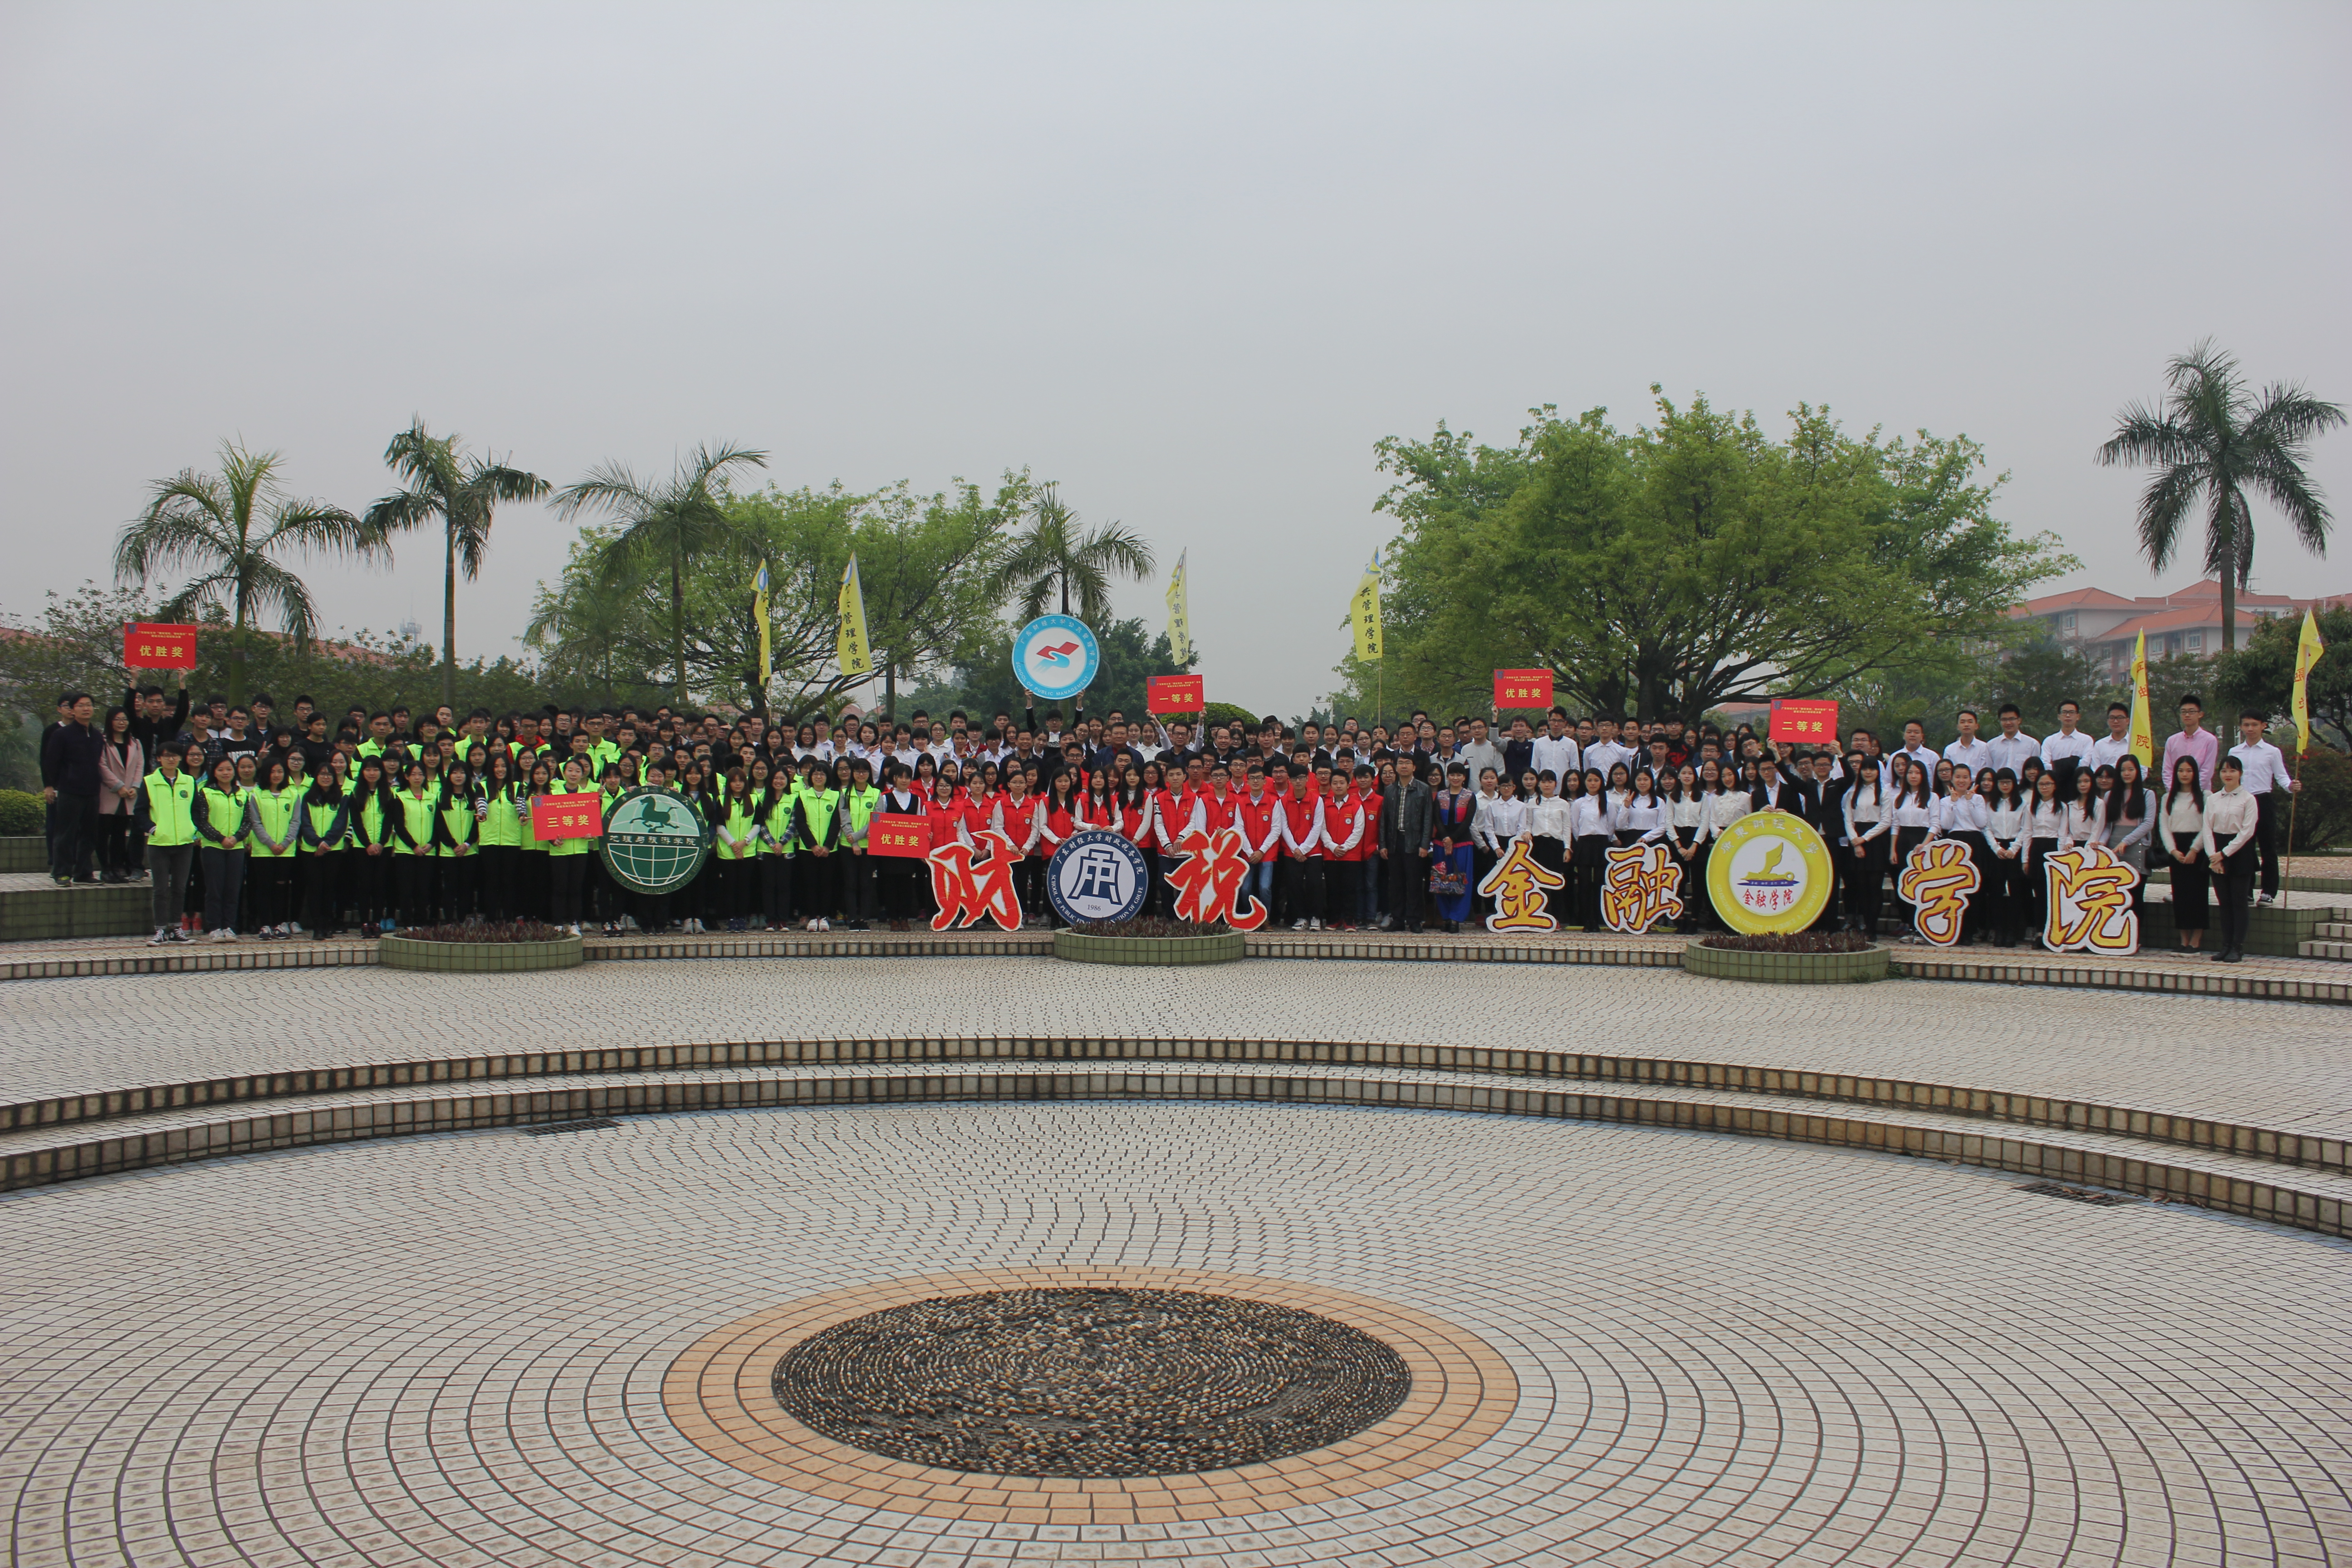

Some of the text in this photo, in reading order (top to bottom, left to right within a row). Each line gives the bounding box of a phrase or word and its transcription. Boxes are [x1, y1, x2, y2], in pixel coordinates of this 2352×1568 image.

[139, 645, 183, 658] 优胜奖
[1020, 618, 1096, 666] 广东财经大学公共管理学院
[1016, 662, 1027, 682] SCHOOL
[1034, 686, 1054, 696] PUBLIC
[1056, 676, 1089, 696] MANAGEMENT
[1505, 688, 1541, 698] 优胜奖
[1159, 693, 1193, 703] 一等奖
[1782, 720, 1823, 733] 二等奖
[547, 814, 589, 828] 三等奖
[881, 833, 919, 847] 优胜奖
[1056, 833, 1144, 875] 广东财经大学财政税务学院
[928, 831, 1024, 931] 财
[1164, 830, 1267, 931] 税
[1483, 840, 1563, 930] 金
[1603, 846, 1682, 931] 融
[1901, 844, 1976, 943] 学
[2046, 848, 2135, 948] 院
[1060, 905, 1077, 921] PUBLIC
[1134, 886, 1143, 904] GDUFE
[1742, 887, 1794, 911] 金融学院
